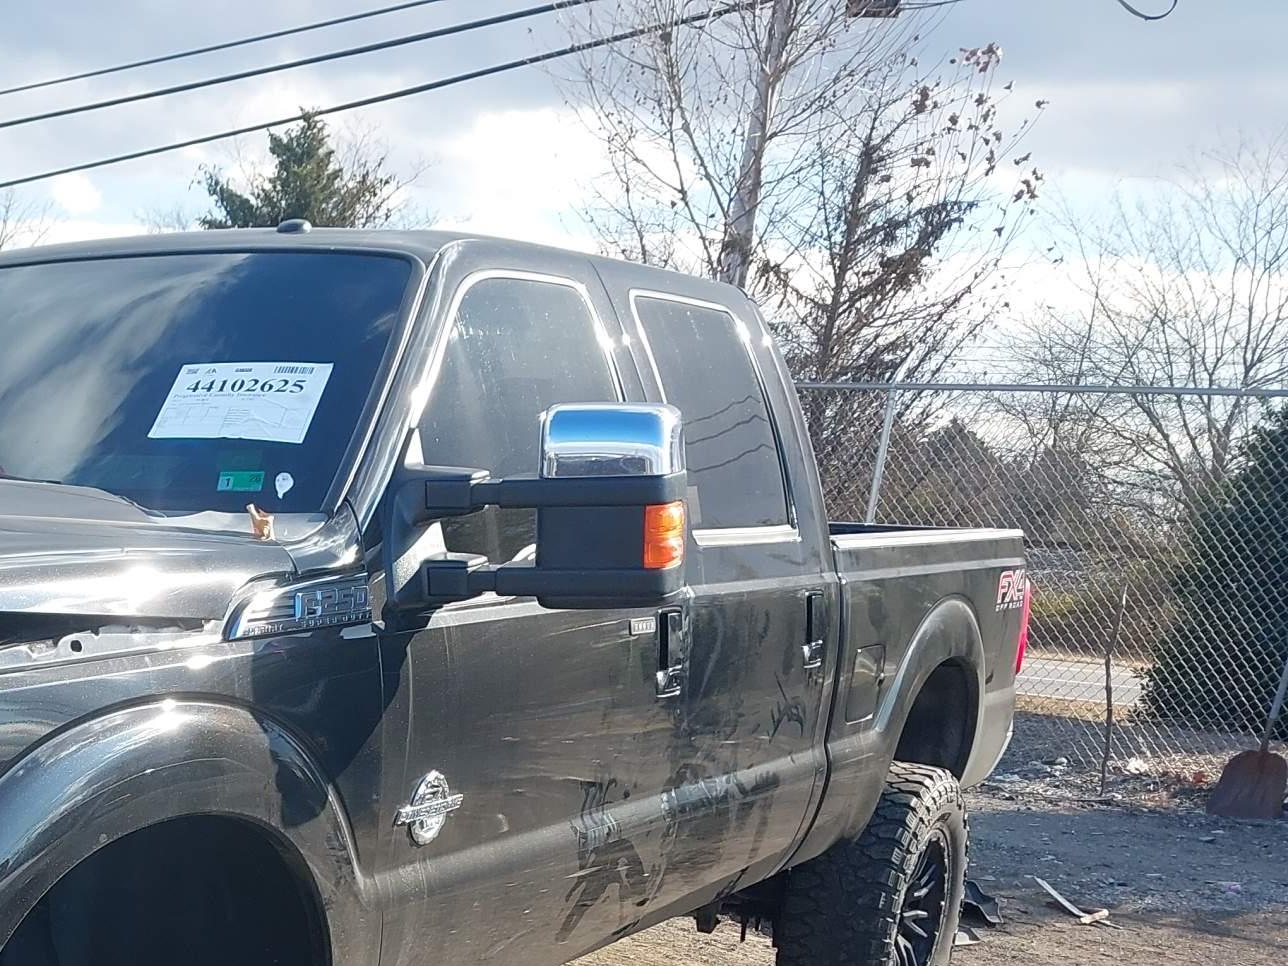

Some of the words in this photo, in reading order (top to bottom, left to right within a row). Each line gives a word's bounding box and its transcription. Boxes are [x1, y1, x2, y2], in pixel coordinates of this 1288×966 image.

[186, 378, 307, 394] 44102625
[225, 477, 231, 487] 1
[997, 569, 1024, 603] FX4
